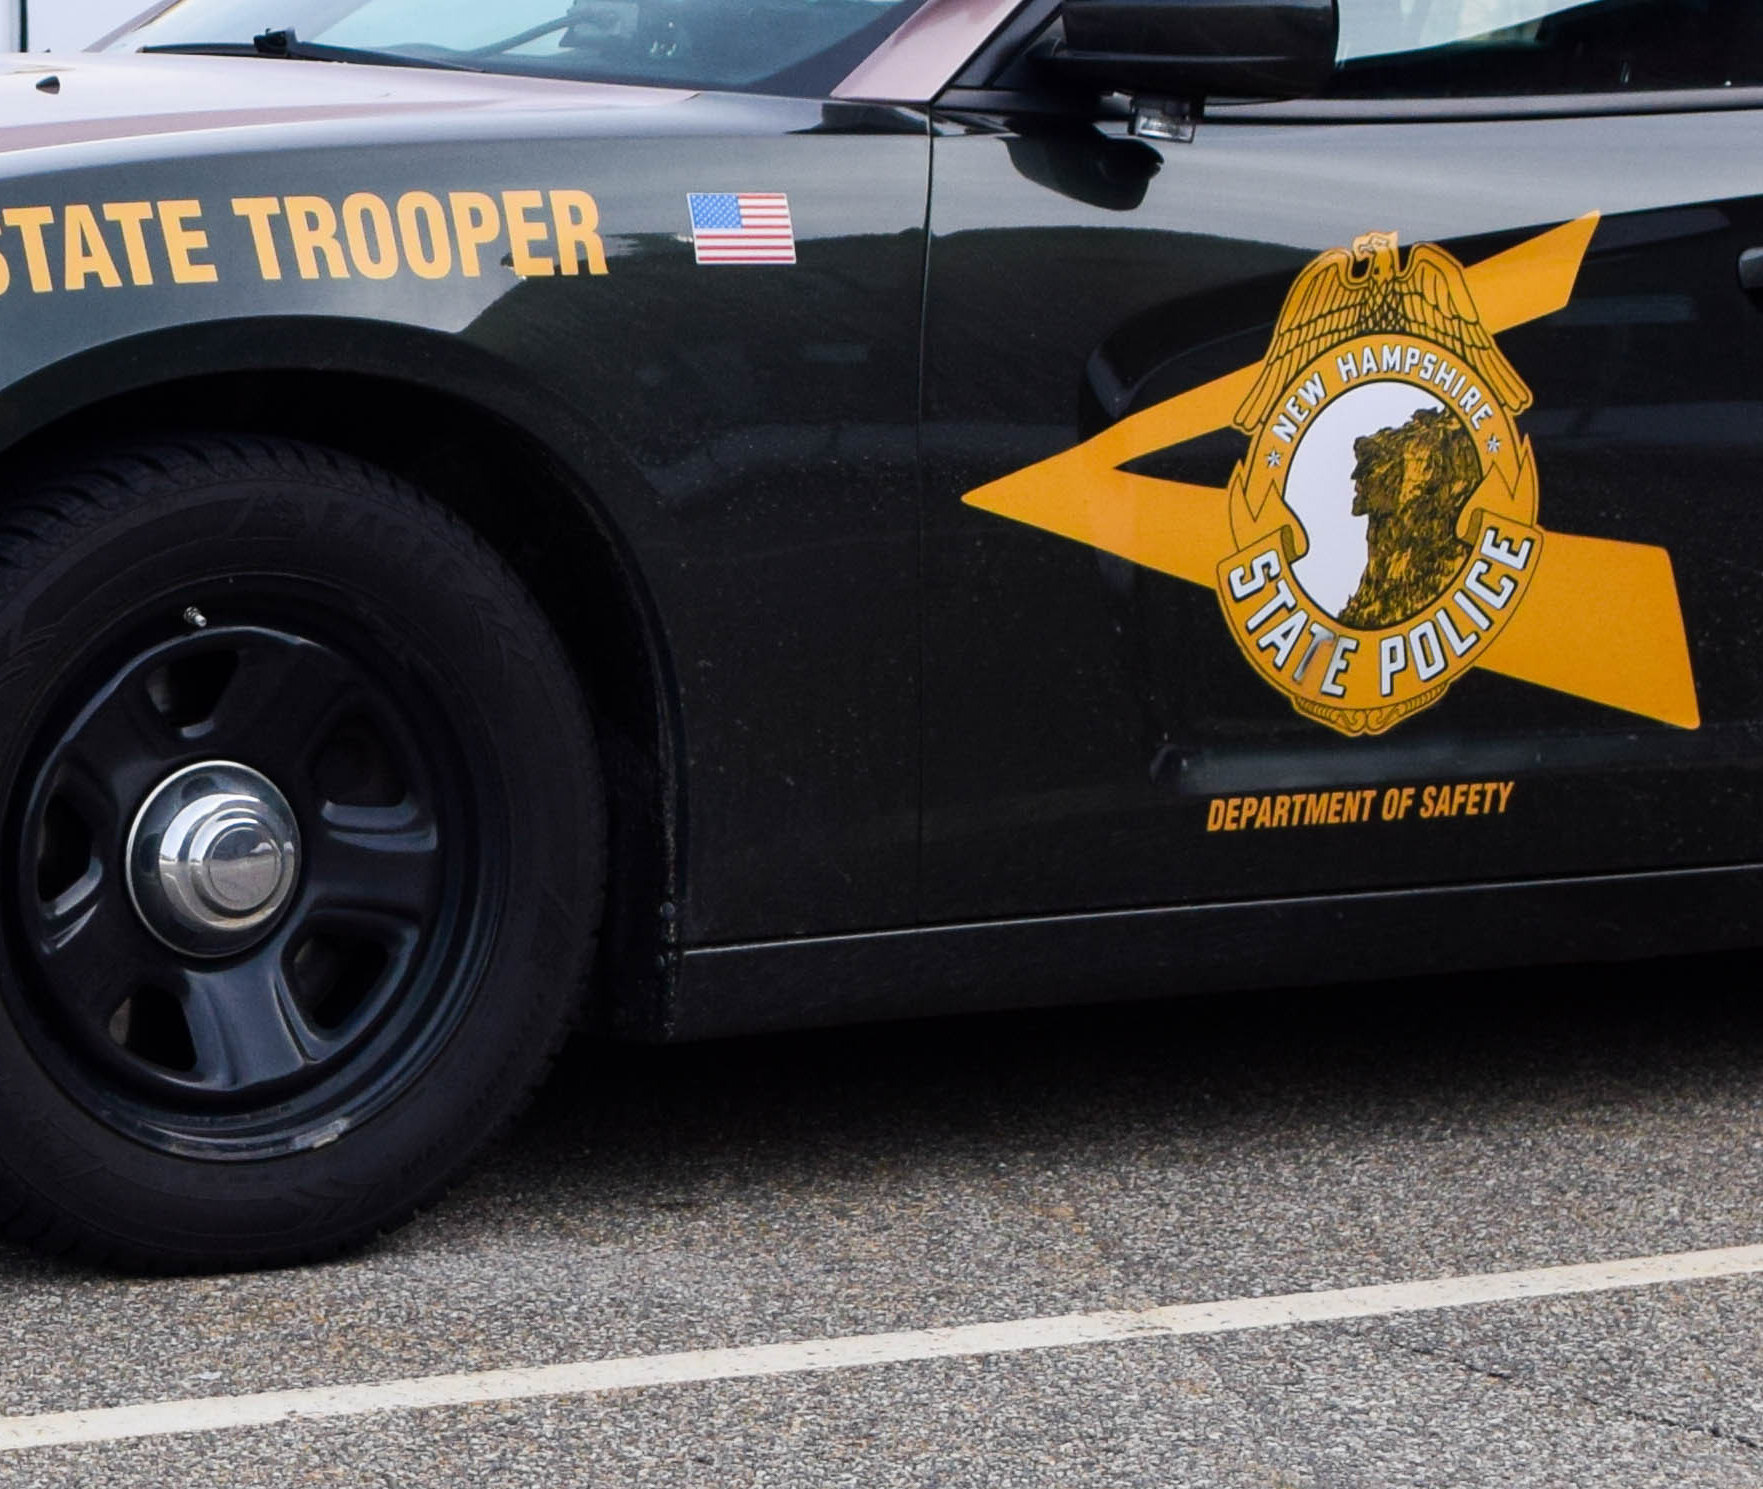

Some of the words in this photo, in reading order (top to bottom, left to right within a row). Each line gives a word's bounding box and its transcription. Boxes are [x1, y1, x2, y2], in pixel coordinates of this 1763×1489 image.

[232, 189, 609, 281] TROOPER
[1272, 372, 1327, 444] NEW
[1337, 344, 1494, 430] HAMPSHIRE
[1229, 550, 1359, 697] STATE
[1380, 527, 1534, 697] POLICE
[1206, 789, 1377, 832] DEPARTMENT
[1381, 787, 1416, 821] OF
[1420, 781, 1516, 818] SAFETY
